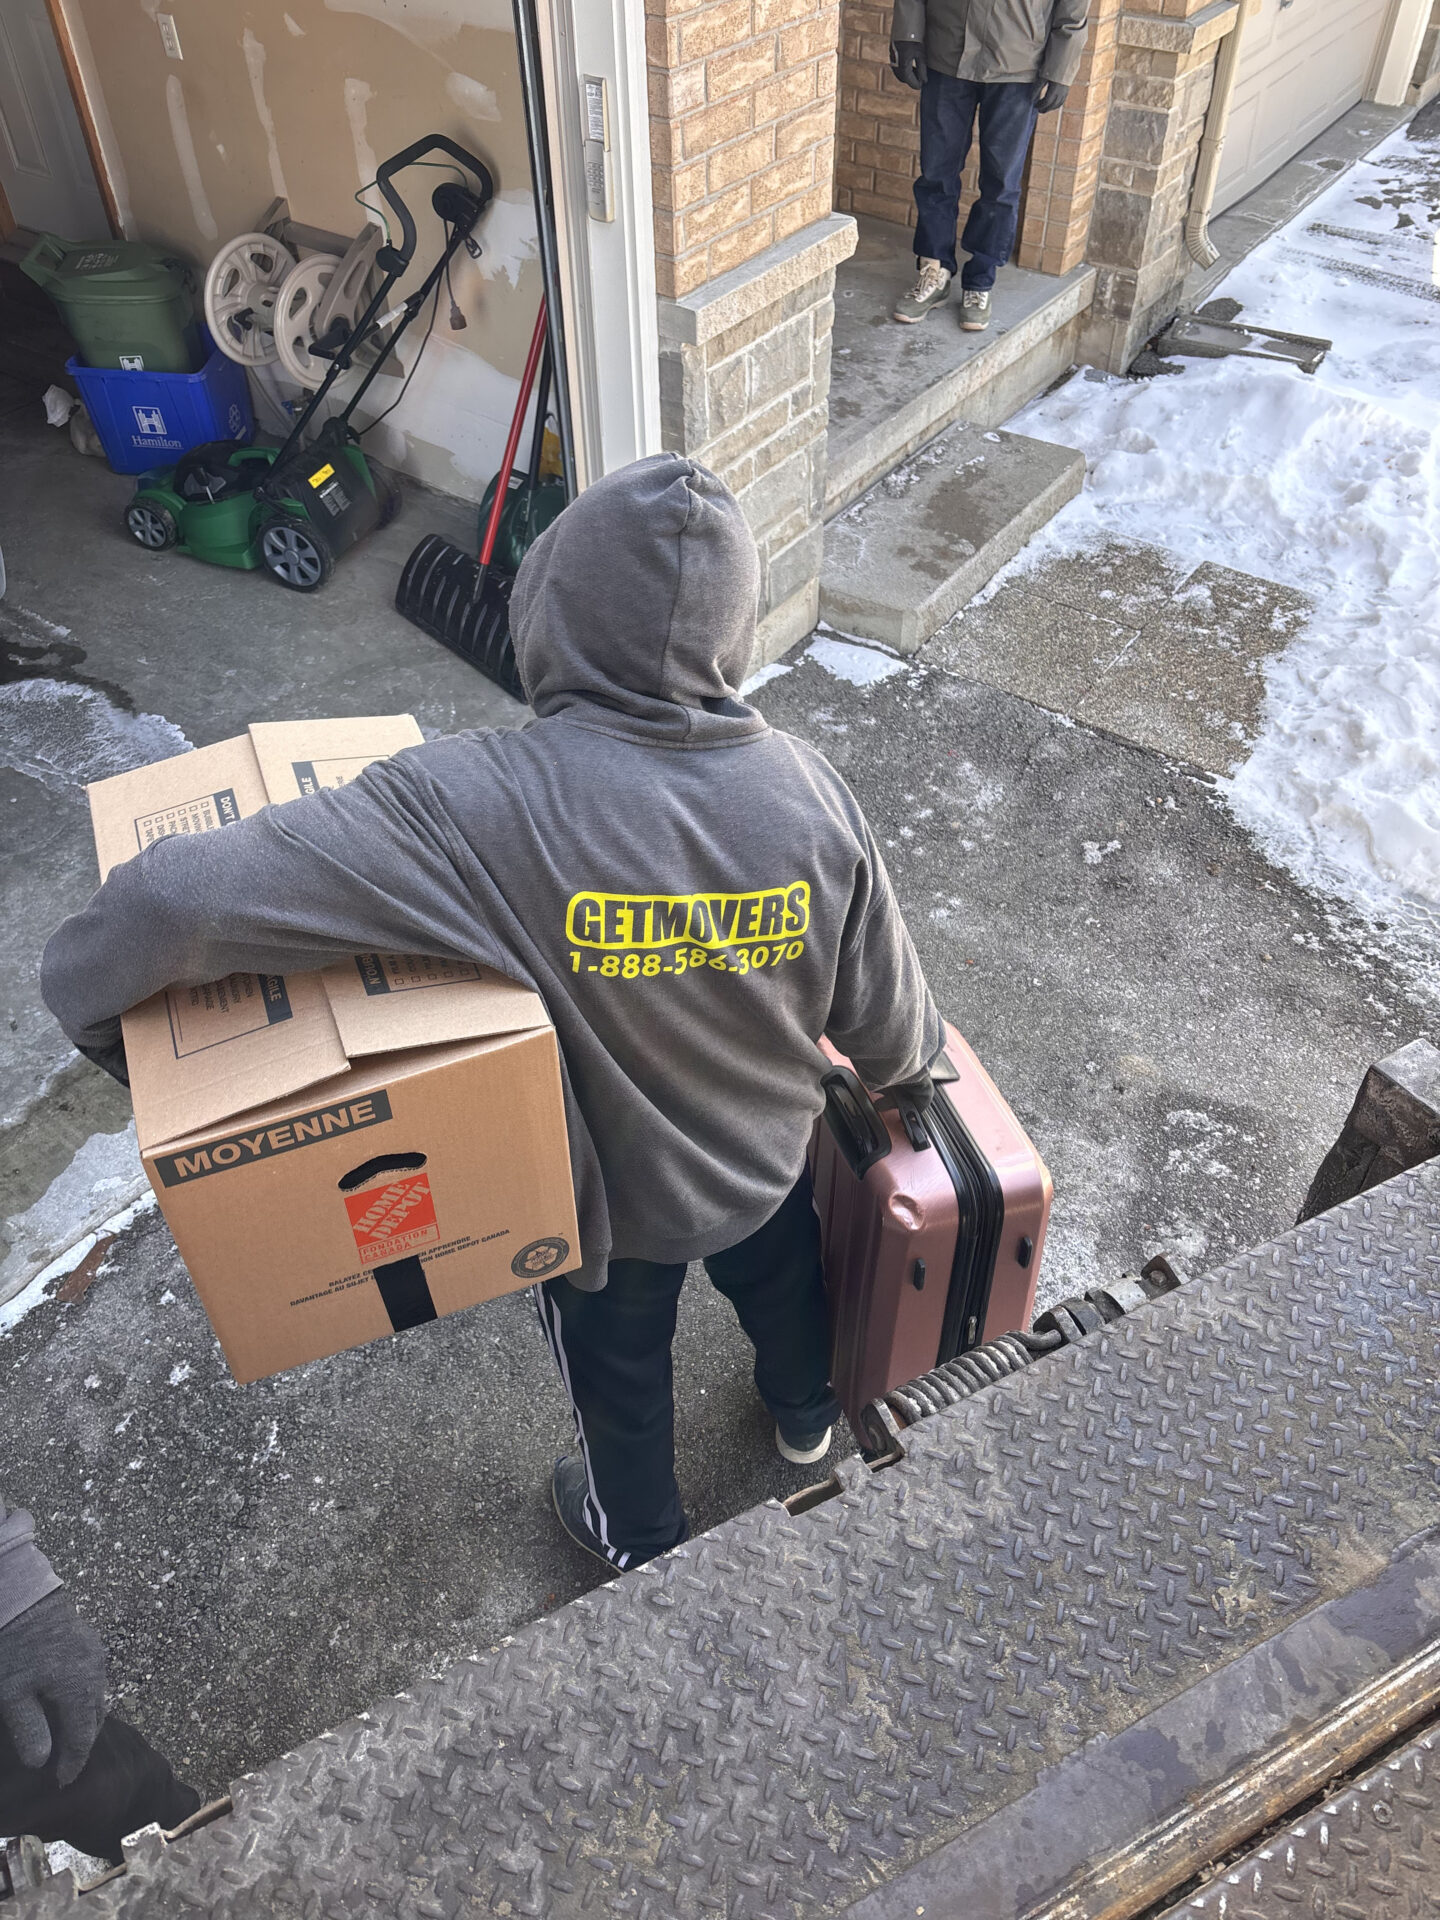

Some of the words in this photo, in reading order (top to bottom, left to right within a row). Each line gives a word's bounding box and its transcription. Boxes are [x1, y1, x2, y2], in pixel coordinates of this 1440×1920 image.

[132, 435, 182, 448] Hamilton
[301, 776, 315, 795] GILE
[220, 795, 235, 820] DON'T
[568, 883, 810, 947] GETMOVERS
[569, 941, 804, 979] 1-888-586-3070
[266, 974, 282, 1002] AGILE
[174, 1099, 376, 1177] MOYENNE
[353, 1183, 410, 1233] HOME
[369, 1182, 430, 1239] DEPOT
[363, 1229, 428, 1255] FONDATION
[364, 1241, 412, 1261] CANADA
[290, 1288, 333, 1307] DAVANTAGE
[435, 1248, 457, 1259] HOME
[457, 1240, 480, 1252] DEPOT
[481, 1229, 511, 1243] CANADA
[328, 1273, 361, 1288] BALAYEZ
[428, 1236, 471, 1255] APPRENDRE
